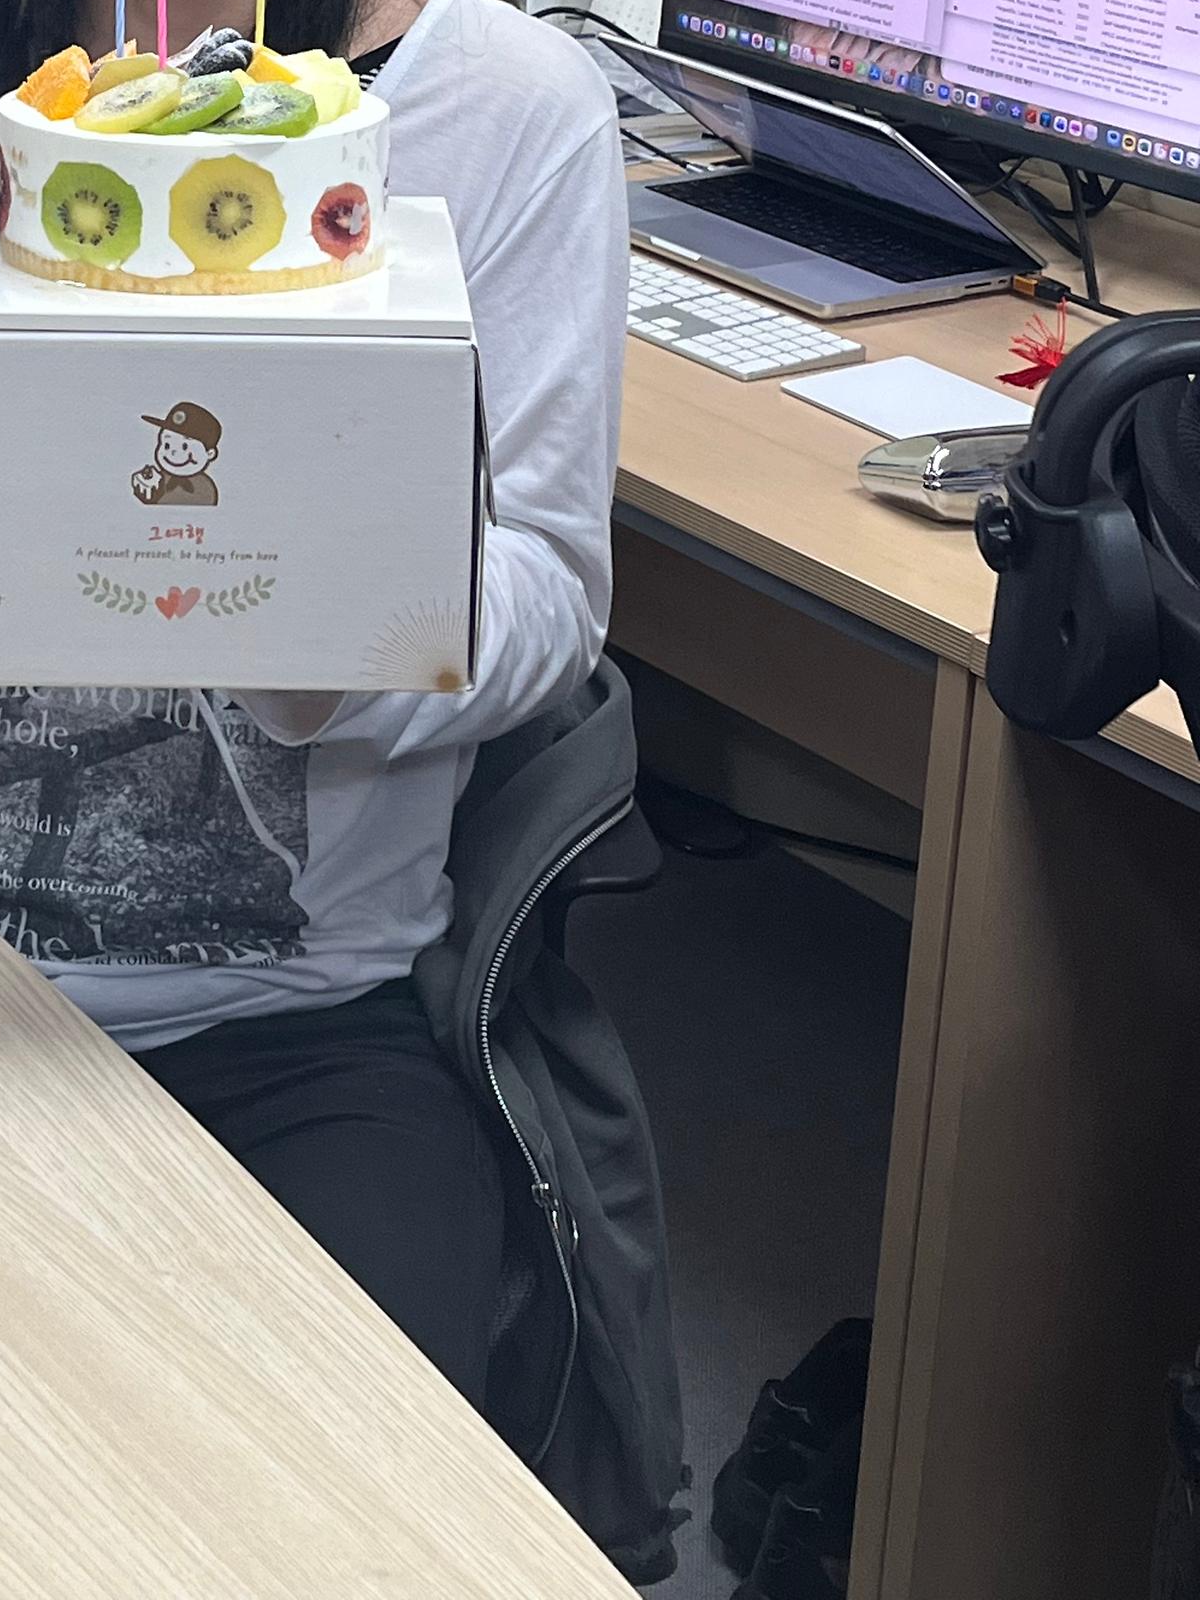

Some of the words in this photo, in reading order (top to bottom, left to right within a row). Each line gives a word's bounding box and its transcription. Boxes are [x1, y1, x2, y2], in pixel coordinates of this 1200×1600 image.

[87, 548, 130, 562] pleasant
[180, 550, 192, 560] be
[195, 550, 226, 564] happy
[230, 550, 253, 561] from
[0, 809, 52, 835] world
[56, 816, 72, 837] is
[27, 875, 140, 903] overcoming
